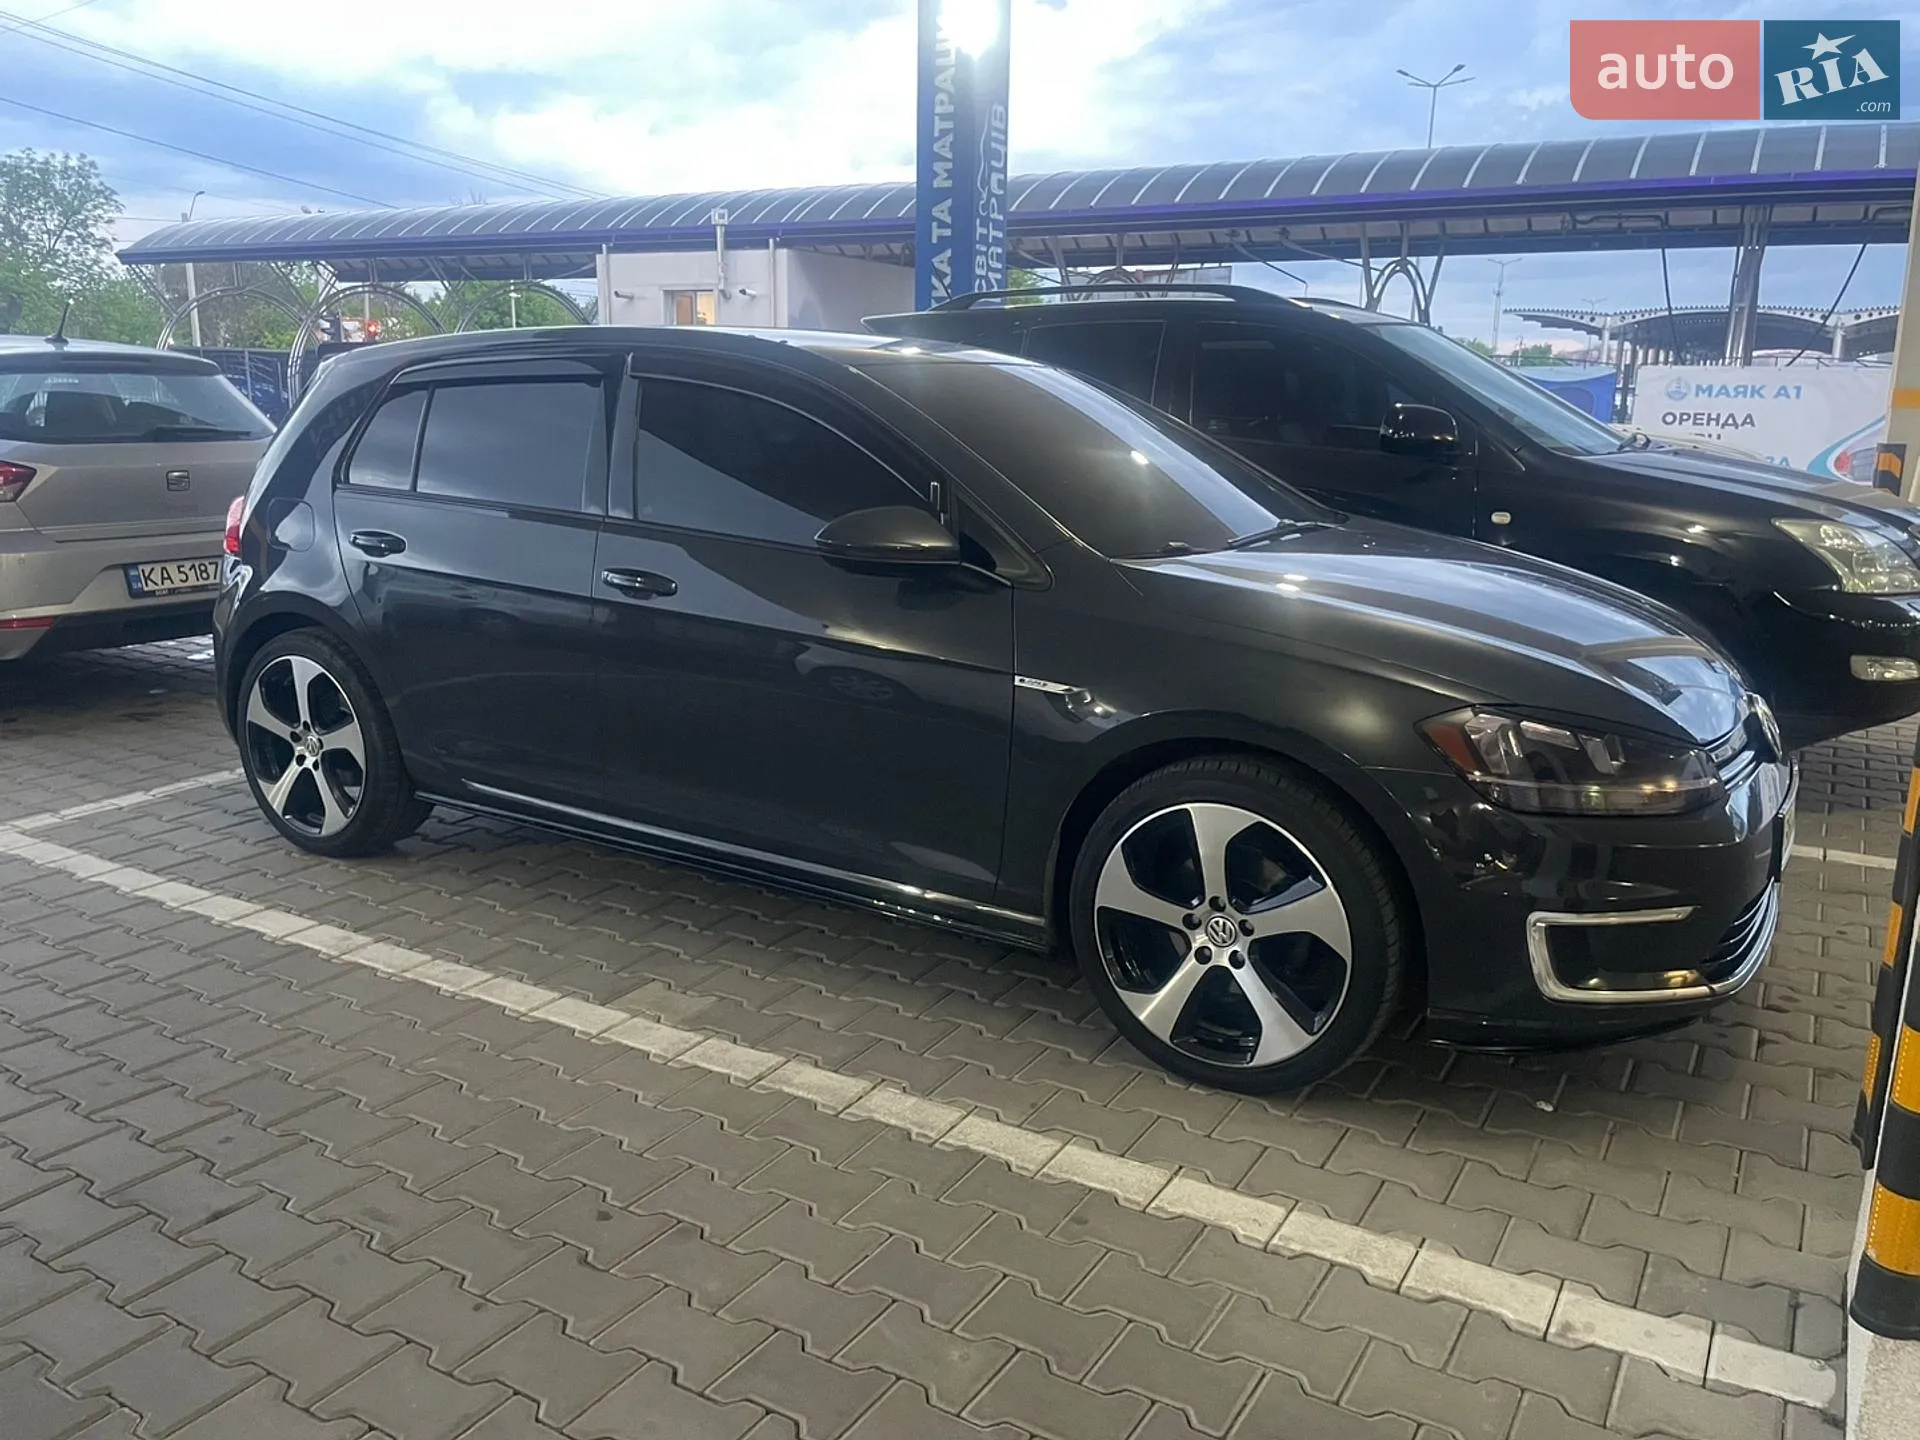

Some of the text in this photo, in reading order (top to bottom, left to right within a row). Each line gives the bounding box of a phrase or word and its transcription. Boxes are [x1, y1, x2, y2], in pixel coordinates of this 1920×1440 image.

[931, 198, 952, 244] ТА
[1695, 384, 1766, 399] МАЯК
[1661, 411, 1756, 429] ОРЕНДА
[141, 561, 219, 588] KA 5187
